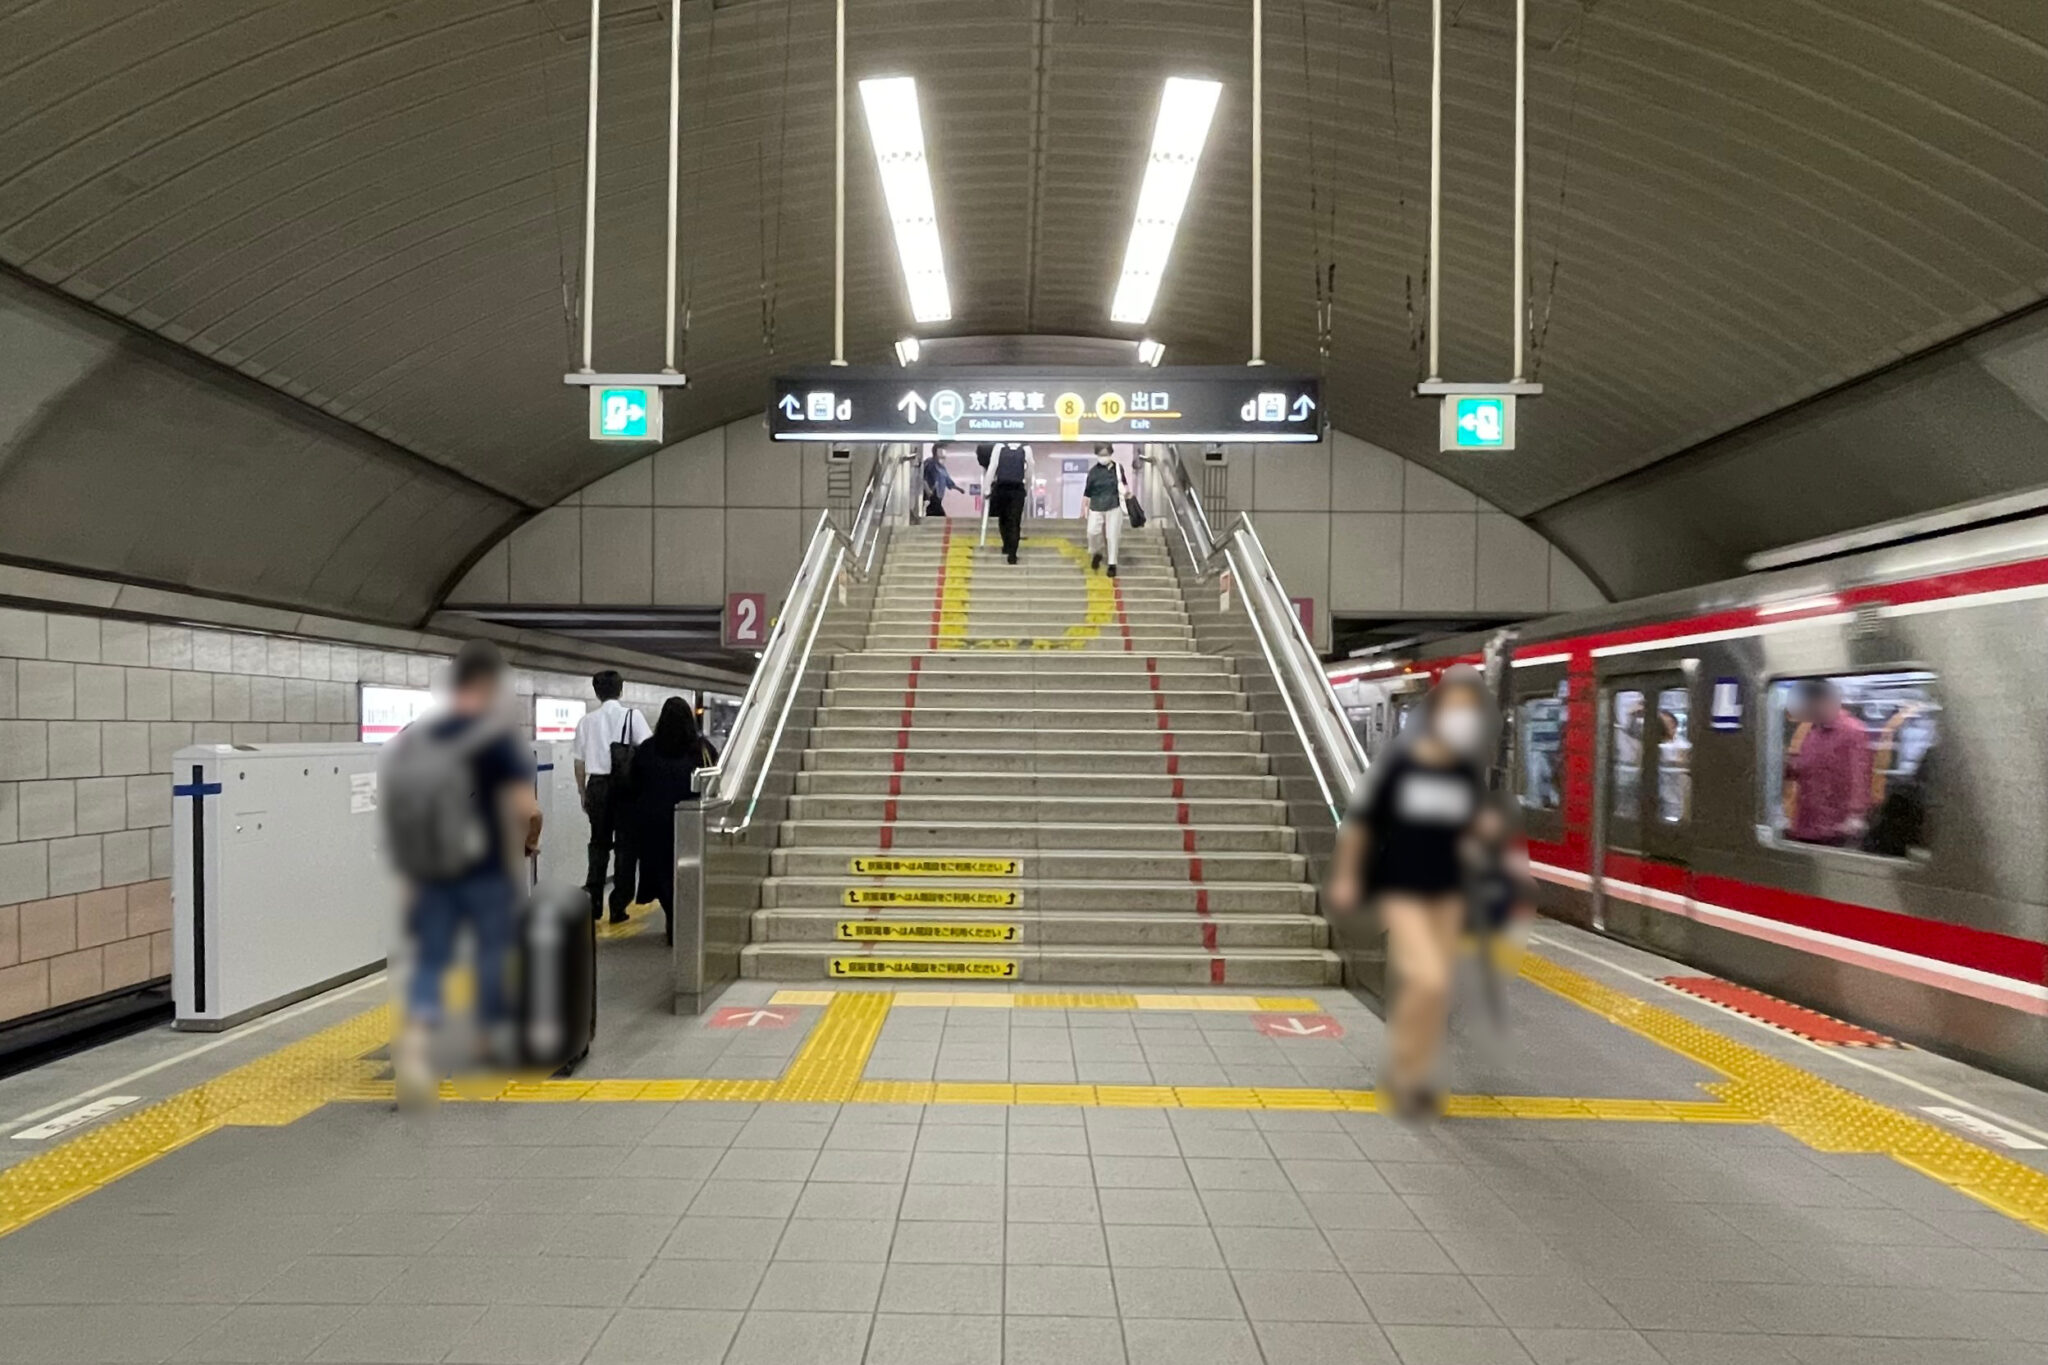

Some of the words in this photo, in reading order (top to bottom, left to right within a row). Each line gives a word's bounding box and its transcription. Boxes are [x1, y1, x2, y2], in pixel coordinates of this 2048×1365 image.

[968, 391, 1046, 411] 京阪電車
[1064, 400, 1075, 415] 8
[1101, 400, 1120, 415] 10
[1130, 391, 1169, 411] 出口
[968, 419, 1002, 430] Keihan
[1004, 419, 1025, 430] Line
[1130, 419, 1151, 430] Exit
[737, 598, 757, 640] 2
